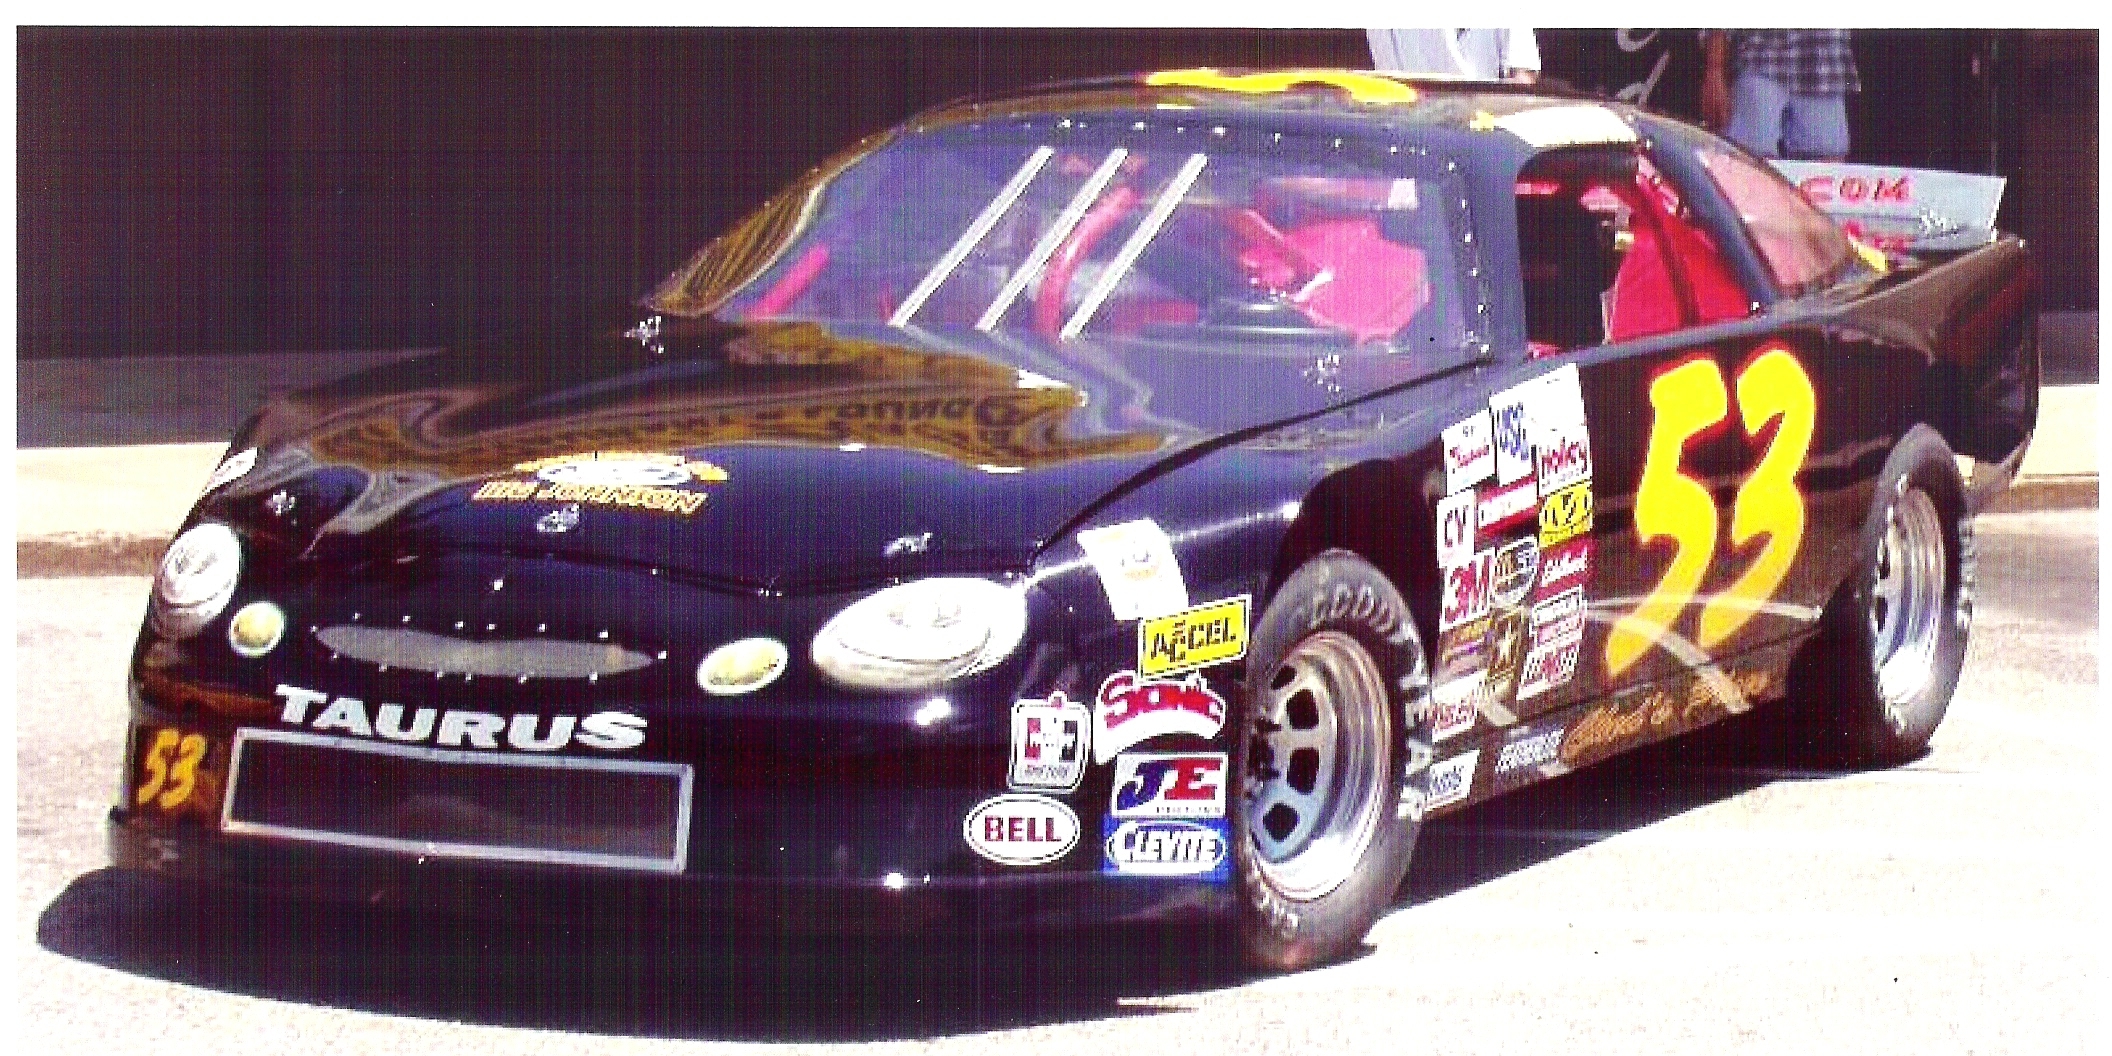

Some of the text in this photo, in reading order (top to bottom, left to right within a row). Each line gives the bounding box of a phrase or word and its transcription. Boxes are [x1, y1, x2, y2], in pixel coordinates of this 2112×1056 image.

[1605, 346, 1816, 677] 53
[1150, 617, 1237, 663] ACCEL
[275, 684, 648, 752] TAURUS
[138, 728, 208, 810] 53
[1116, 758, 1222, 811] JE
[984, 816, 1063, 842] BELL
[1113, 820, 1218, 863] CLEVITE
